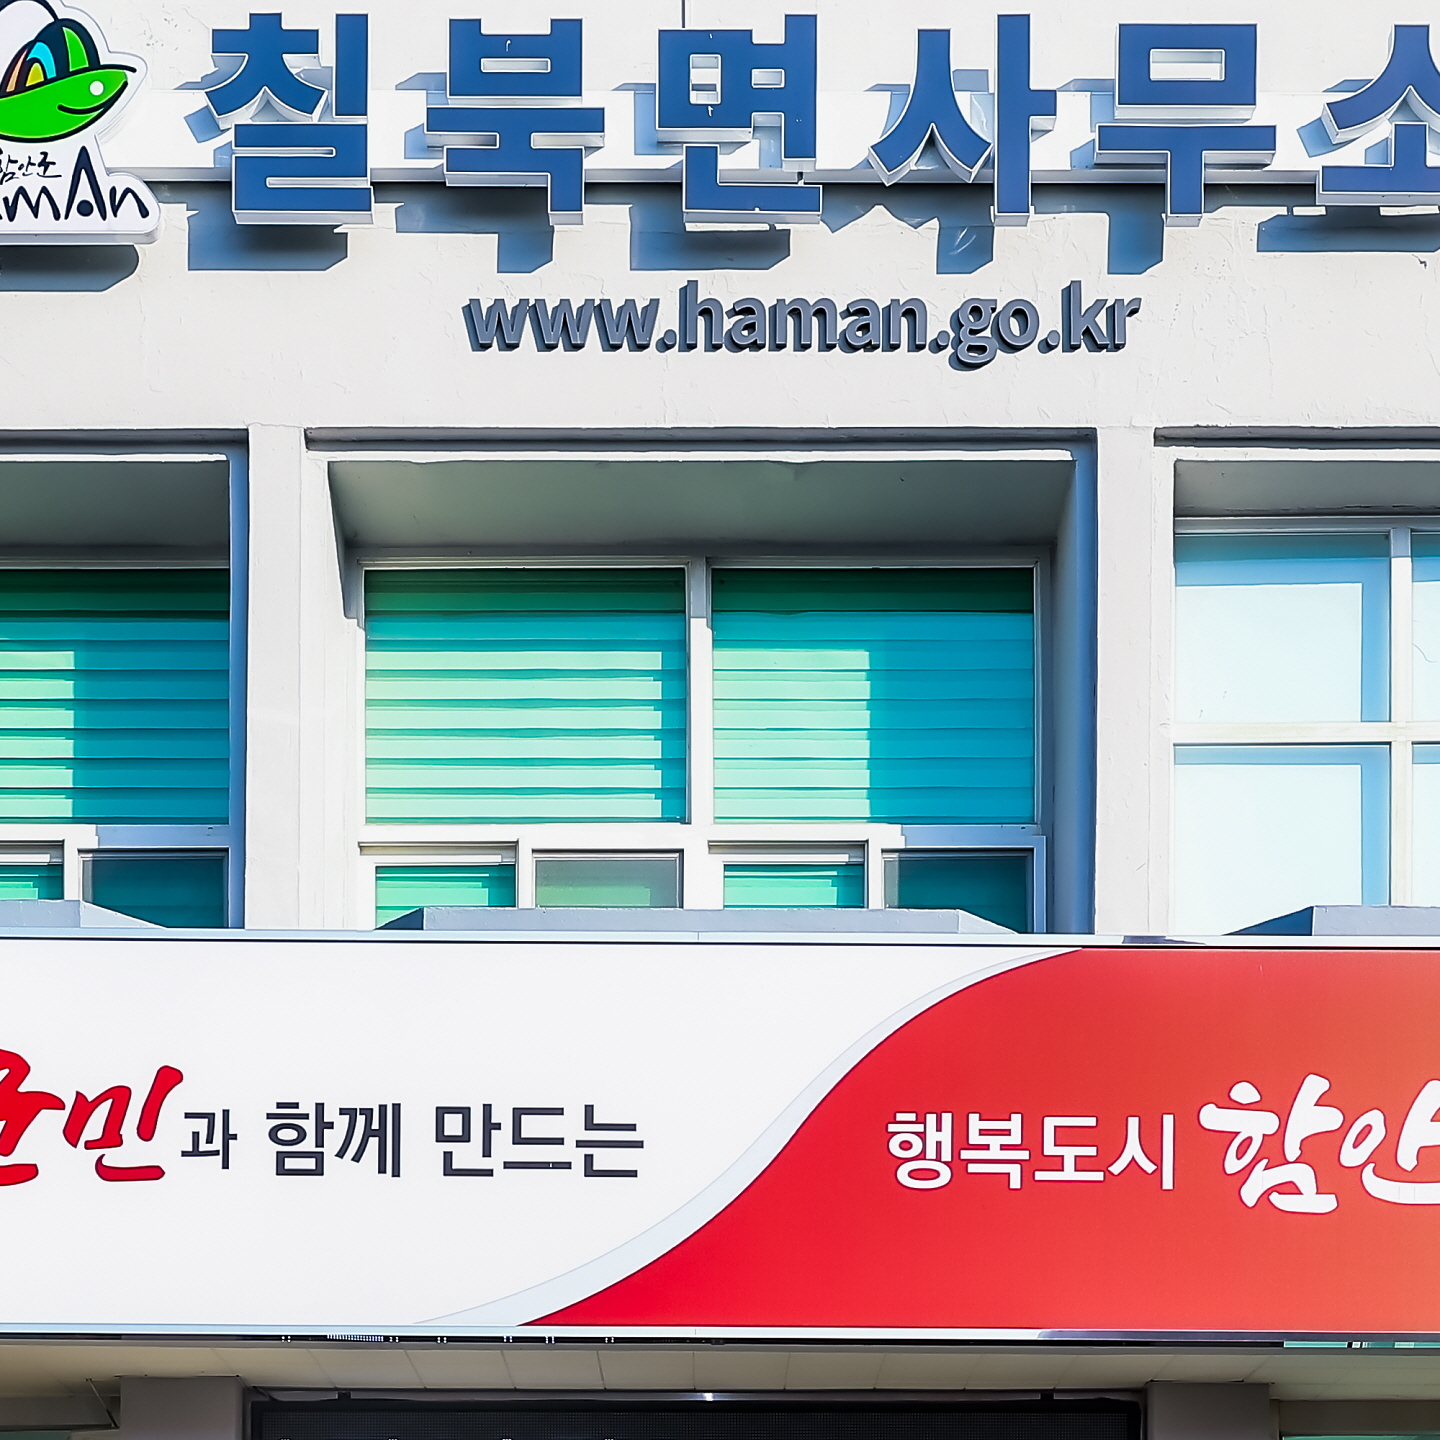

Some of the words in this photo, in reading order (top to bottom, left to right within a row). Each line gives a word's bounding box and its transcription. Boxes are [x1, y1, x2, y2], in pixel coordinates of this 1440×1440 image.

[466, 281, 1142, 366] www.haman.go.kr
[266, 1098, 401, 1182] 함께
[434, 1102, 644, 1179] 만드는
[887, 1107, 1176, 1193] 행복도시
